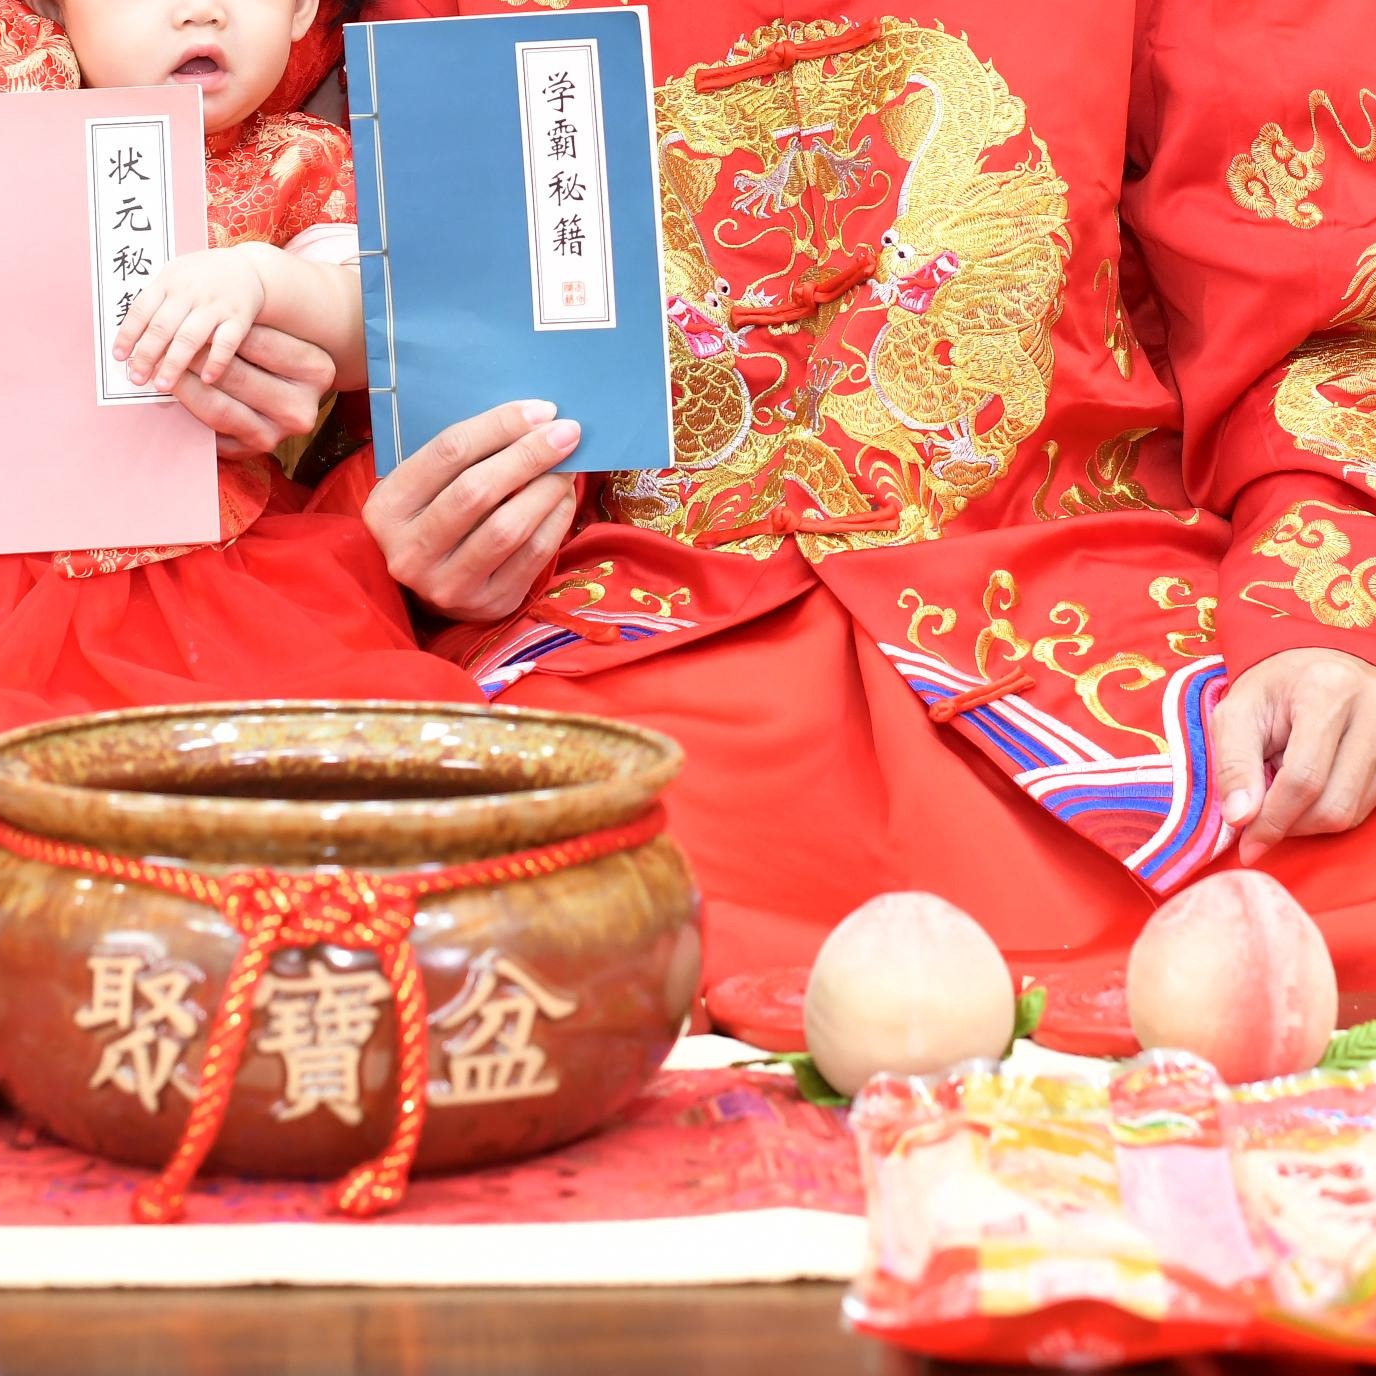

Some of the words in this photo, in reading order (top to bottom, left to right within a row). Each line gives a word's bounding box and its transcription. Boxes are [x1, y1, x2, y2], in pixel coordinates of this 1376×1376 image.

[542, 71, 586, 257] 学霸秘籍
[75, 944, 579, 1126] 聚寶盆
